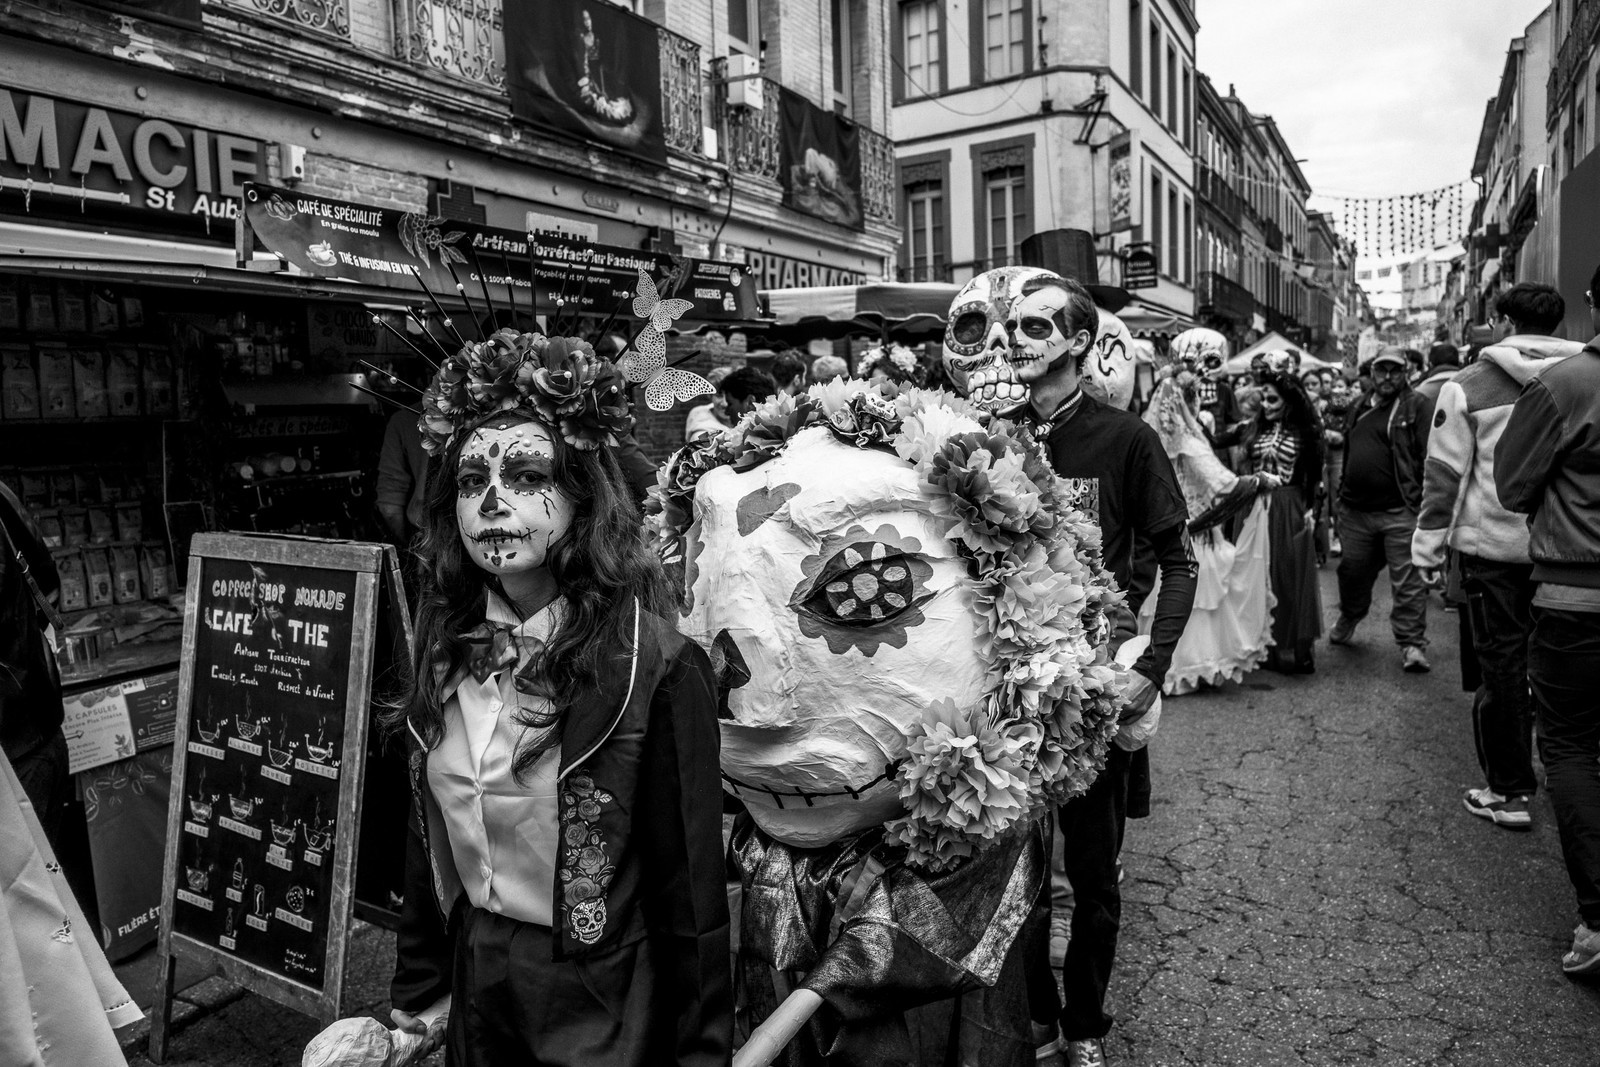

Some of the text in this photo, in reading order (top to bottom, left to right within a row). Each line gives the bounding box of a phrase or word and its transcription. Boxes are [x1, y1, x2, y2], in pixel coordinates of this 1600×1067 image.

[146, 186, 175, 211] St
[297, 199, 383, 227] CAFÉ DE SPÉCIALITÉ
[320, 219, 380, 237] En grains ou moulu
[472, 232, 527, 254] Artisan
[338, 251, 354, 266] THÉ
[359, 256, 391, 272] INFUSION
[390, 262, 402, 274] EN
[749, 252, 866, 290] PHARMACIE
[212, 579, 251, 598] COFFEE
[258, 583, 286, 604] SHOP
[212, 609, 329, 648] CAFE THE
[75, 704, 117, 720] CAPSULES
[117, 912, 149, 937] FILIÈRE
